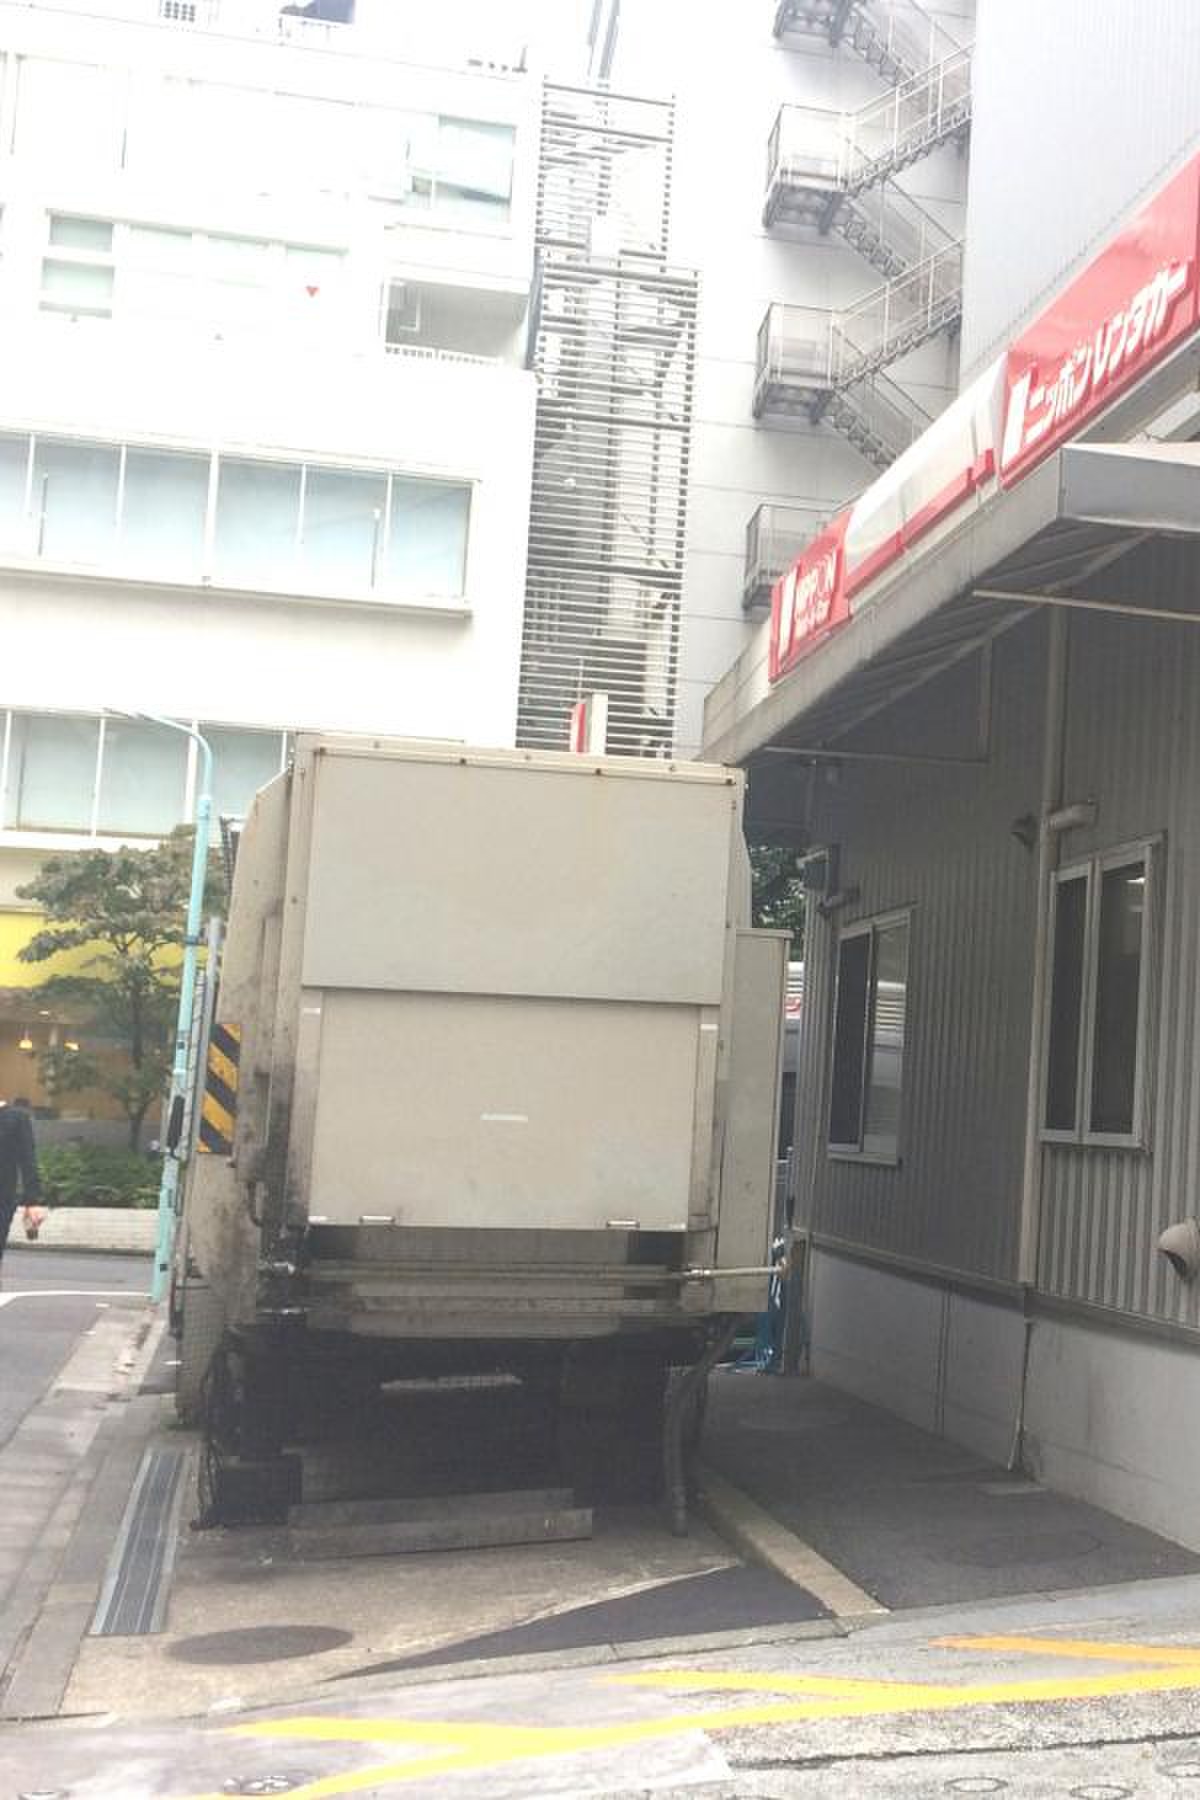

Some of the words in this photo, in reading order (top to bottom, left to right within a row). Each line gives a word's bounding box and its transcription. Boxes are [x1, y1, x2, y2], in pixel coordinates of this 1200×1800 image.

[1023, 260, 1189, 444] ニッポンレンタカー
